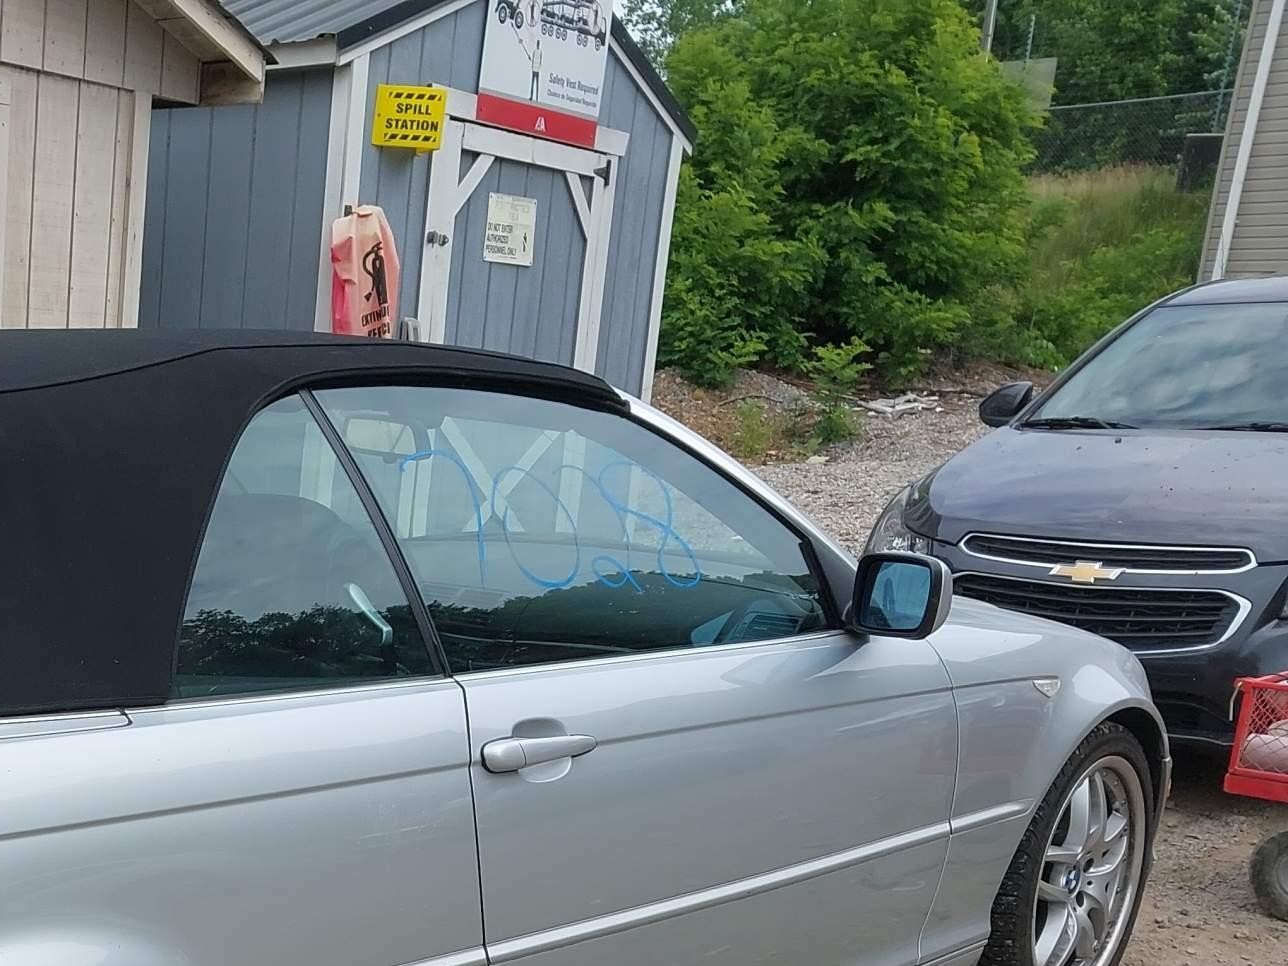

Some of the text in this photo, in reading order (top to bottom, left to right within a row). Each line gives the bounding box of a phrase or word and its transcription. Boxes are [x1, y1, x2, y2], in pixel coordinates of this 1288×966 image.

[396, 103, 432, 115] SPILL
[385, 118, 439, 132] STATION
[399, 449, 701, 594] 7028
